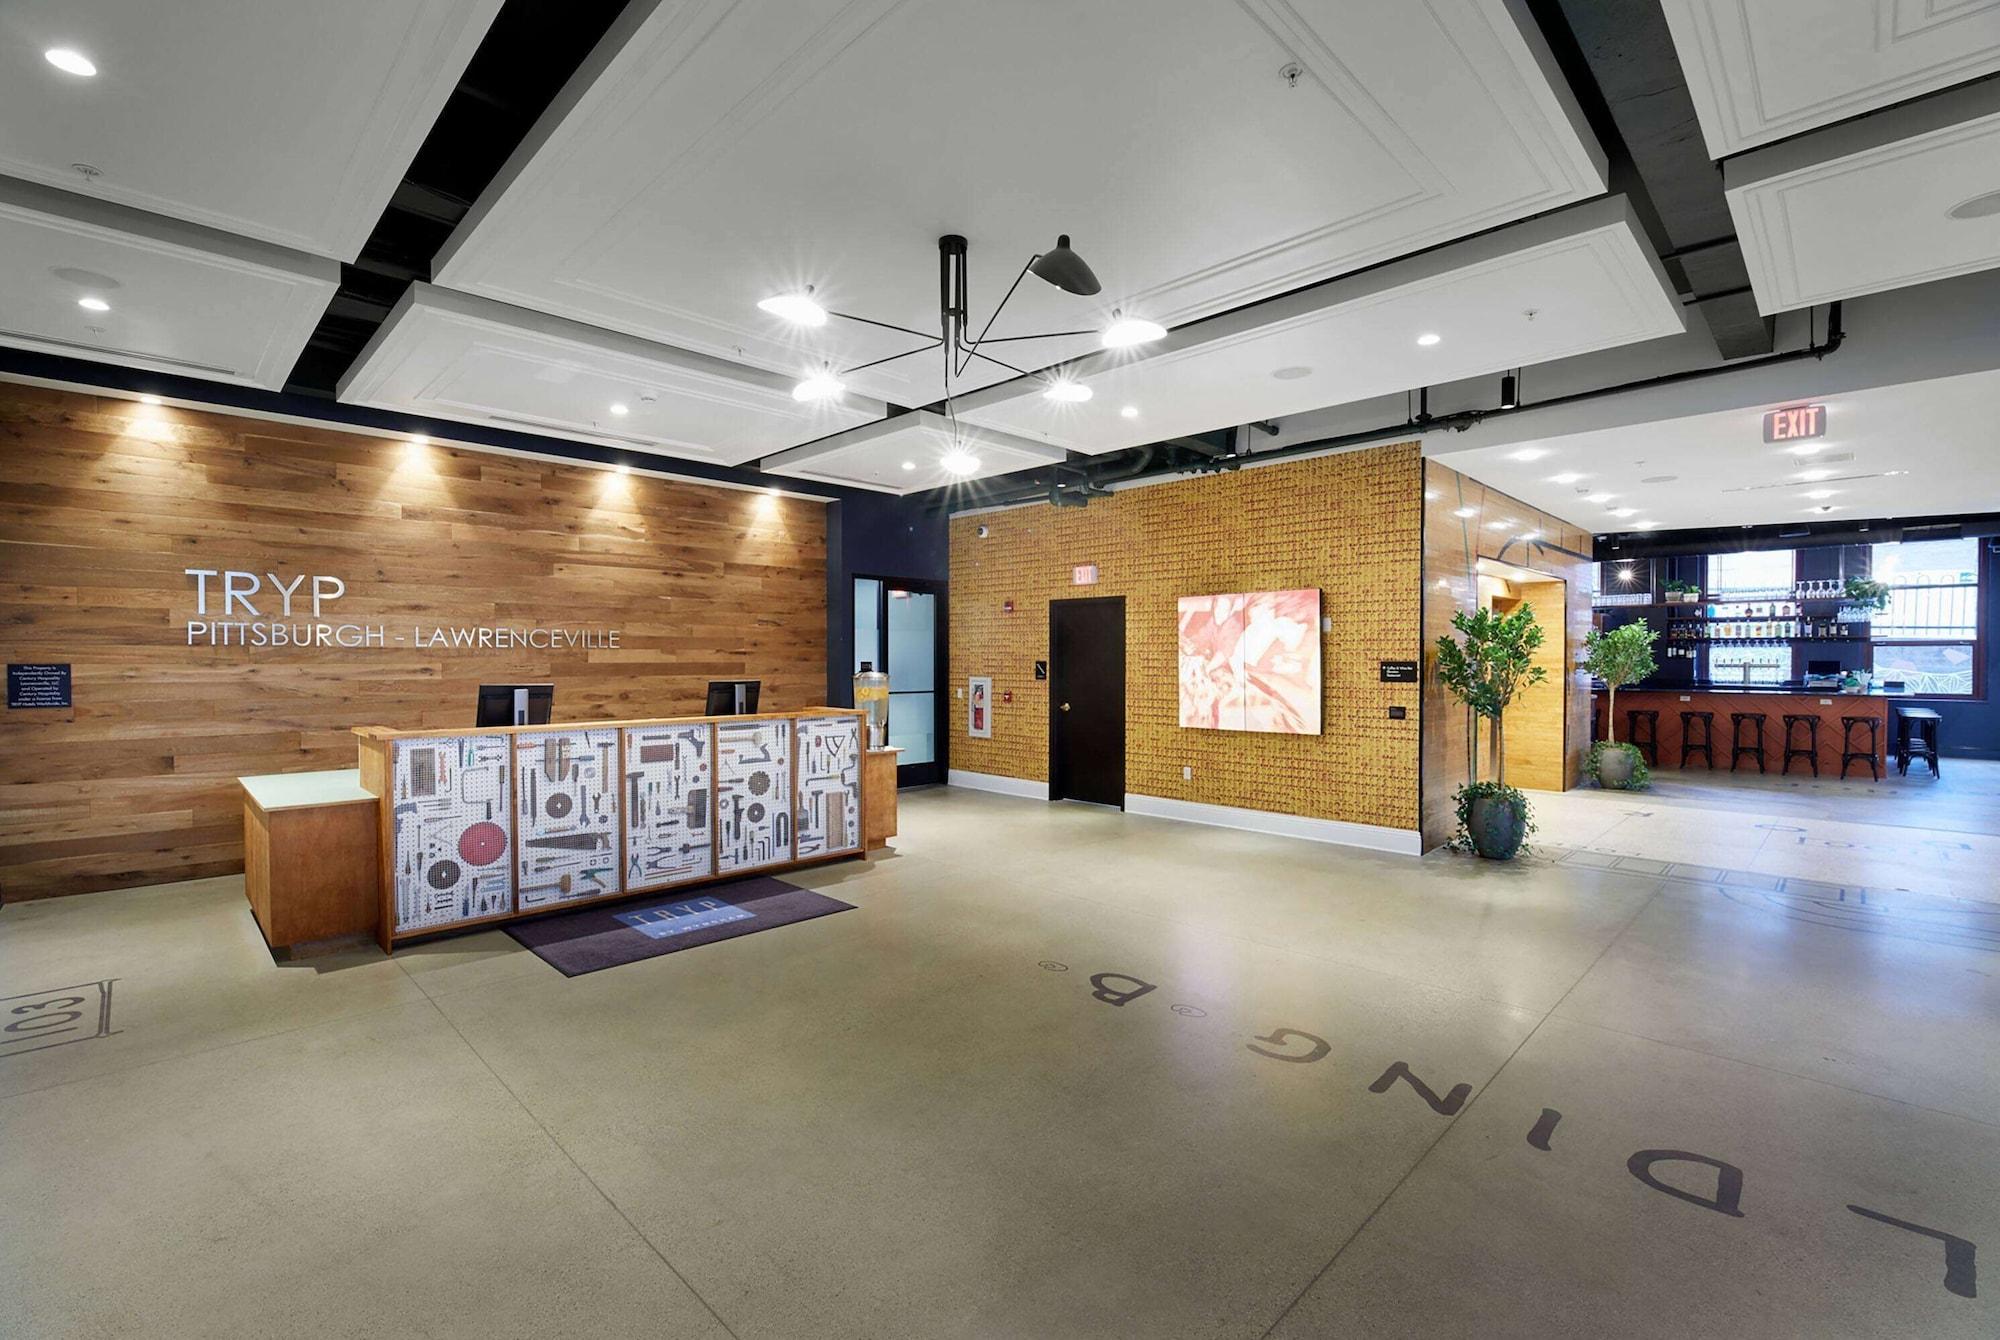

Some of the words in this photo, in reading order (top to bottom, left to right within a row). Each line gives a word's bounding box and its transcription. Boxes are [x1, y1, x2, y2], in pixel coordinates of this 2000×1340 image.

[1773, 407, 1819, 440] EXIT
[1076, 566, 1092, 584] EXIT
[185, 569, 345, 618] TRYP
[187, 621, 385, 648] PITTSBURGH
[415, 627, 621, 650] LAWRENCEVILLE
[629, 901, 716, 925] TRYP
